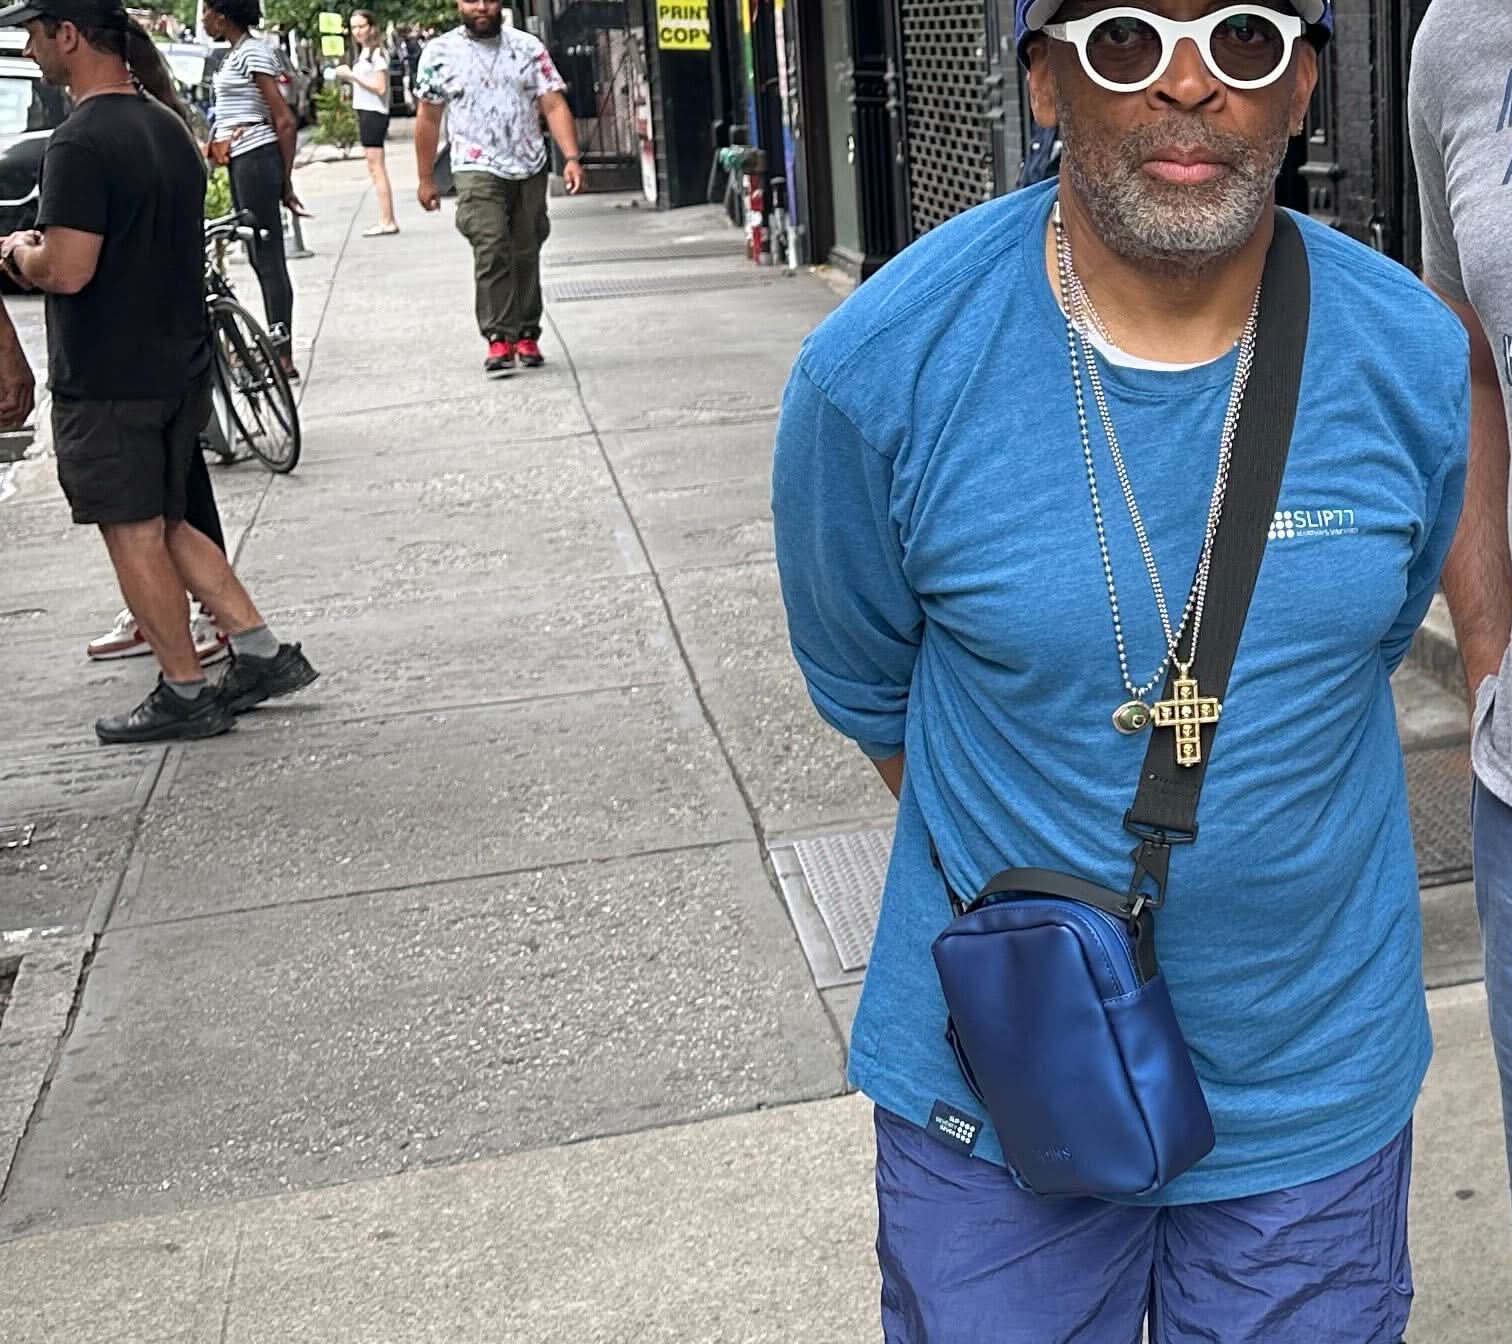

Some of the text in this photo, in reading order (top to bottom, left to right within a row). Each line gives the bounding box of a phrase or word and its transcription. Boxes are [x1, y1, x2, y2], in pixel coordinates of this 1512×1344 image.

[660, 5, 710, 19] PRINT
[660, 27, 711, 43] COPY
[1293, 510, 1355, 528] SLIP77
